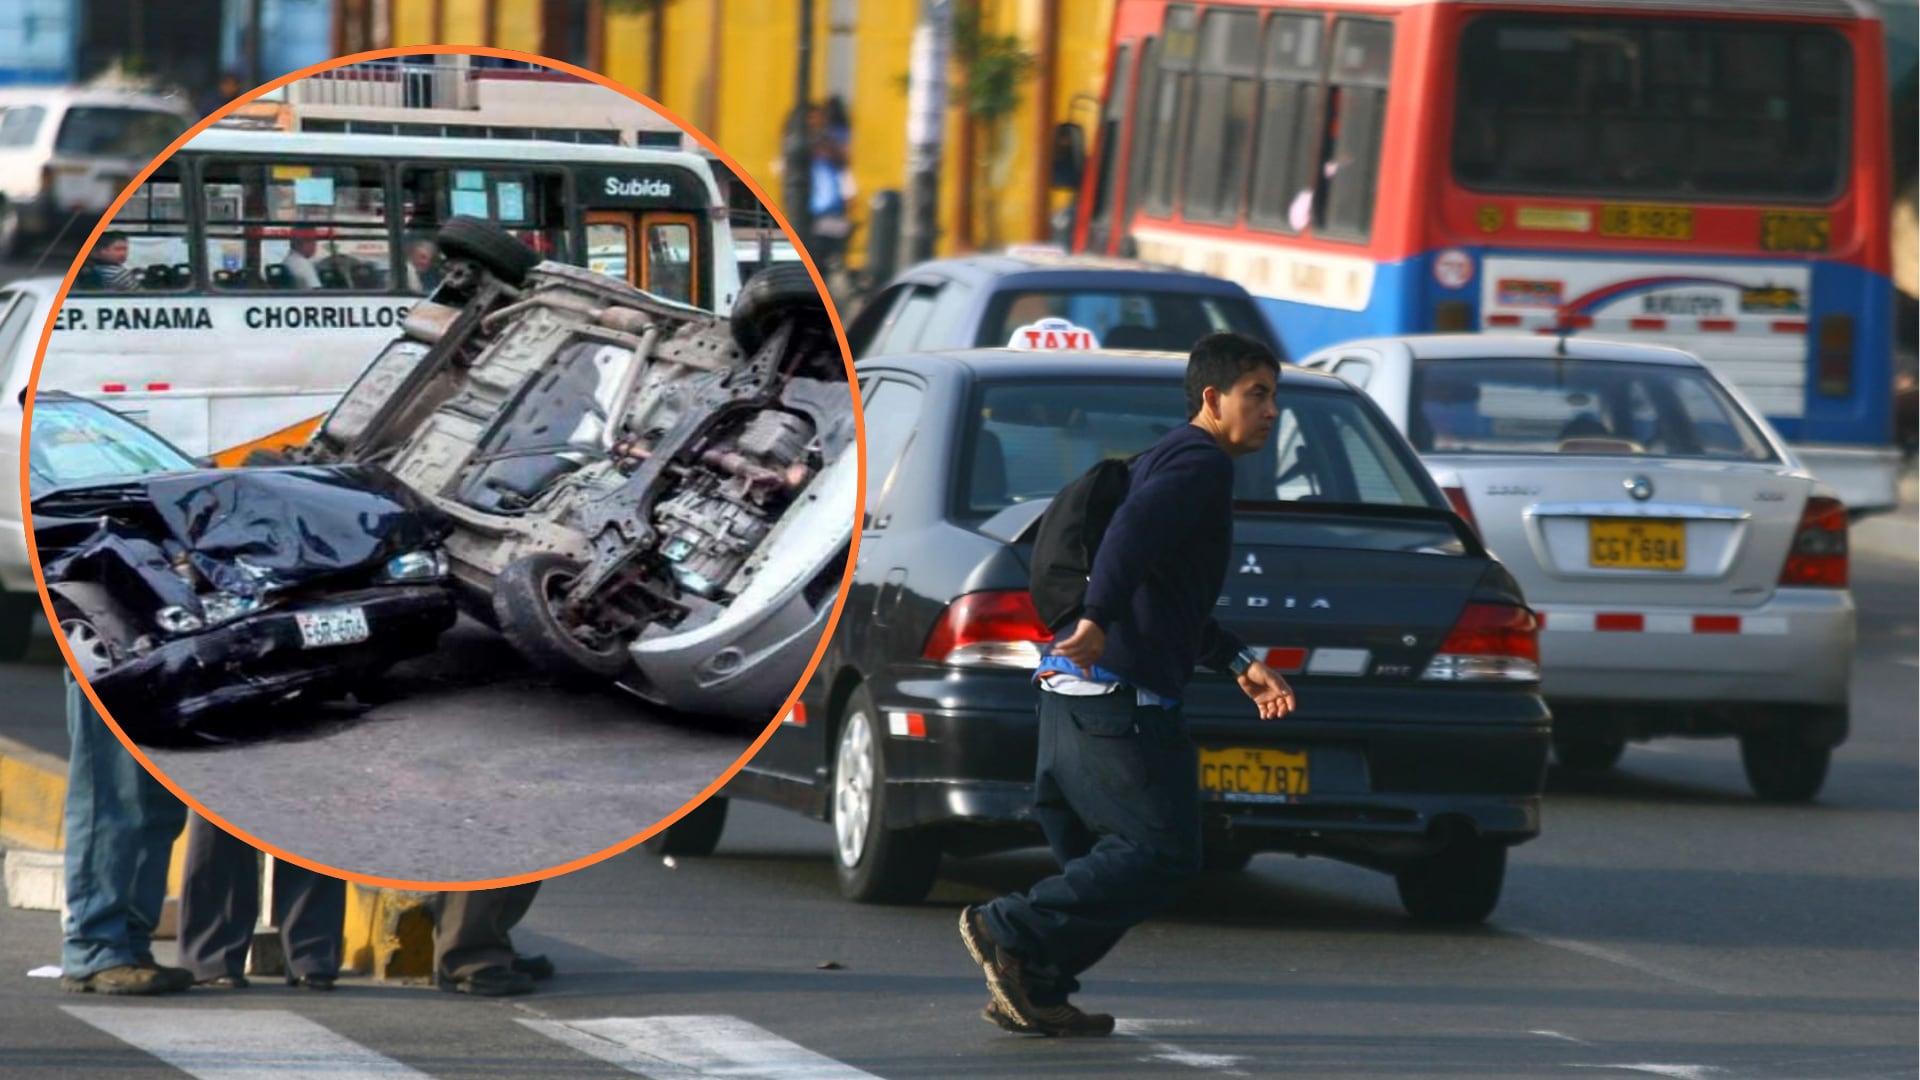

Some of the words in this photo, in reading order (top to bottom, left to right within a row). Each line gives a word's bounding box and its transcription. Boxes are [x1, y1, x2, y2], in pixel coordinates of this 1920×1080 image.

[605, 176, 671, 197] Subida
[97, 307, 213, 330] PANAMA
[245, 306, 410, 329] CHORRILLOS
[1024, 330, 1091, 350] TAXI
